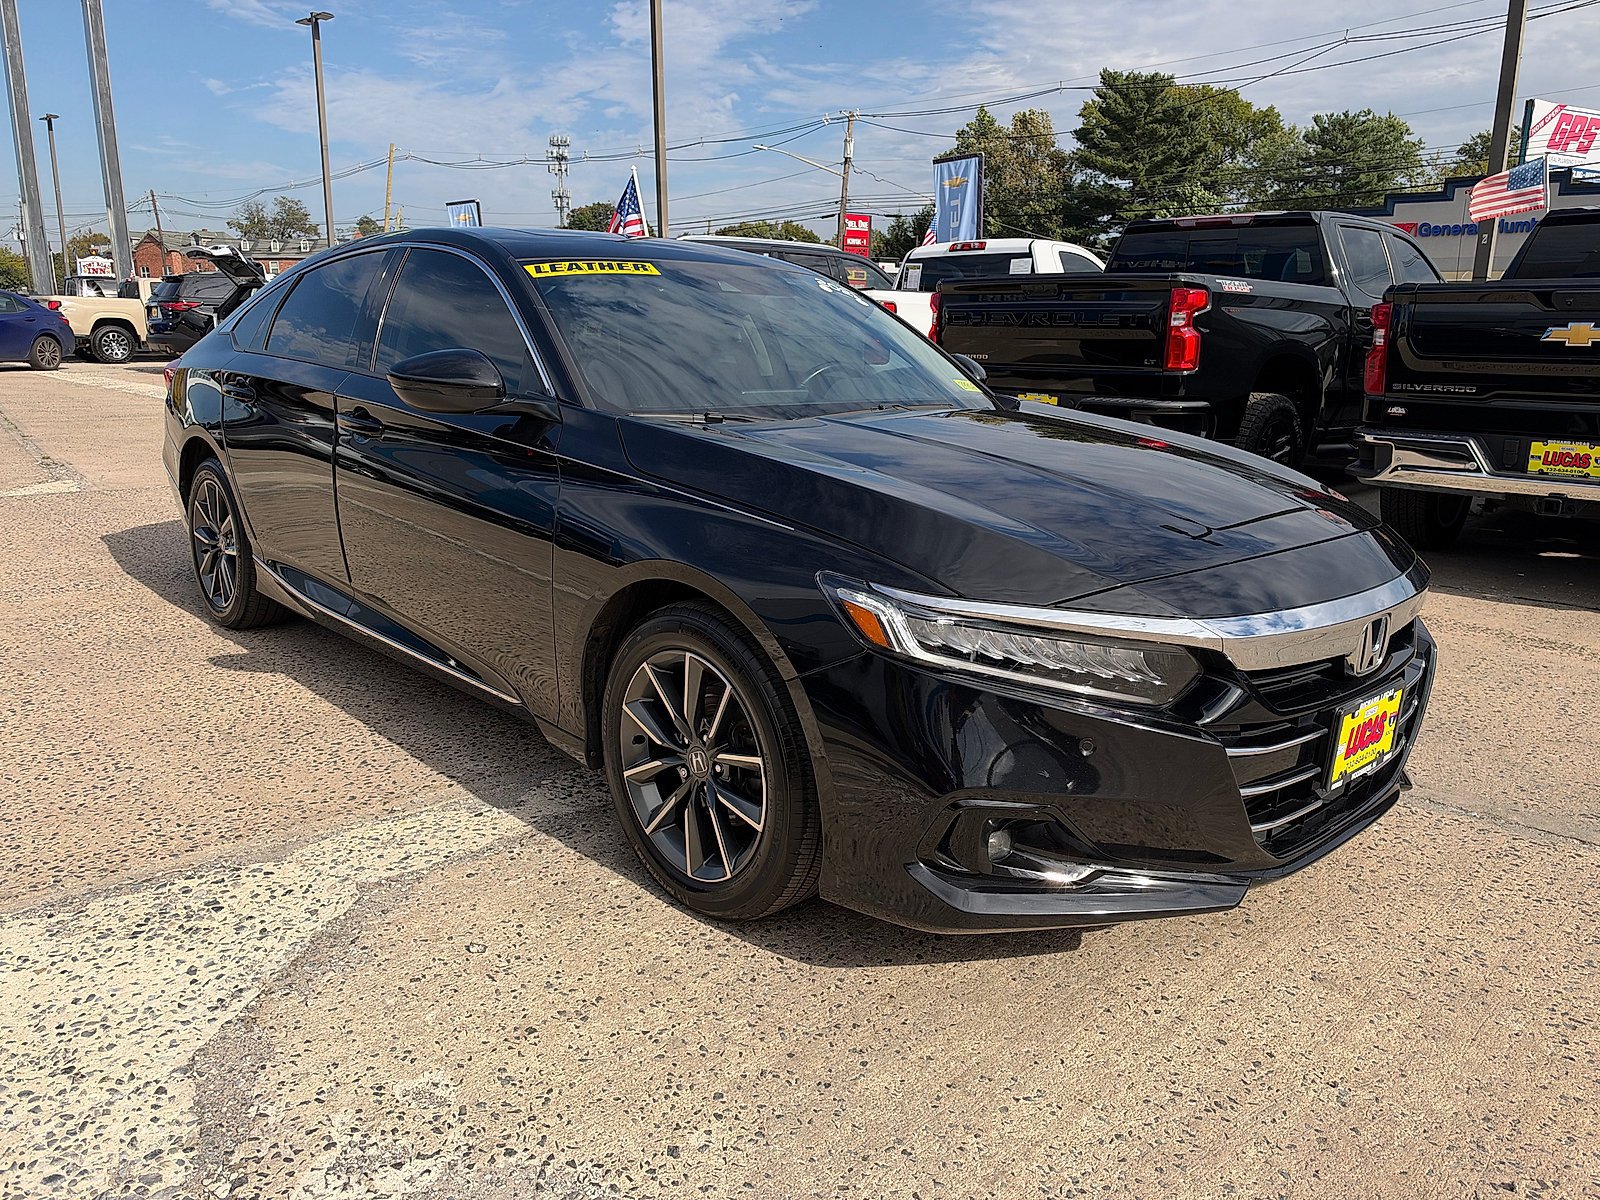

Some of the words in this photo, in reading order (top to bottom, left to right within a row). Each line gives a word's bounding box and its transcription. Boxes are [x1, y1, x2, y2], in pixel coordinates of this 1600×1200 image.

[1531, 119, 1545, 135] NOW
[1546, 112, 1600, 155] GPS
[1481, 233, 1489, 244] 2
[88, 267, 106, 275] INN
[533, 262, 649, 275] LEATHER
[948, 311, 1151, 326] CHEVROLET
[1392, 383, 1477, 393] SILVERADO
[1542, 450, 1592, 469] LUCAS
[1344, 710, 1388, 761] LUCAS
